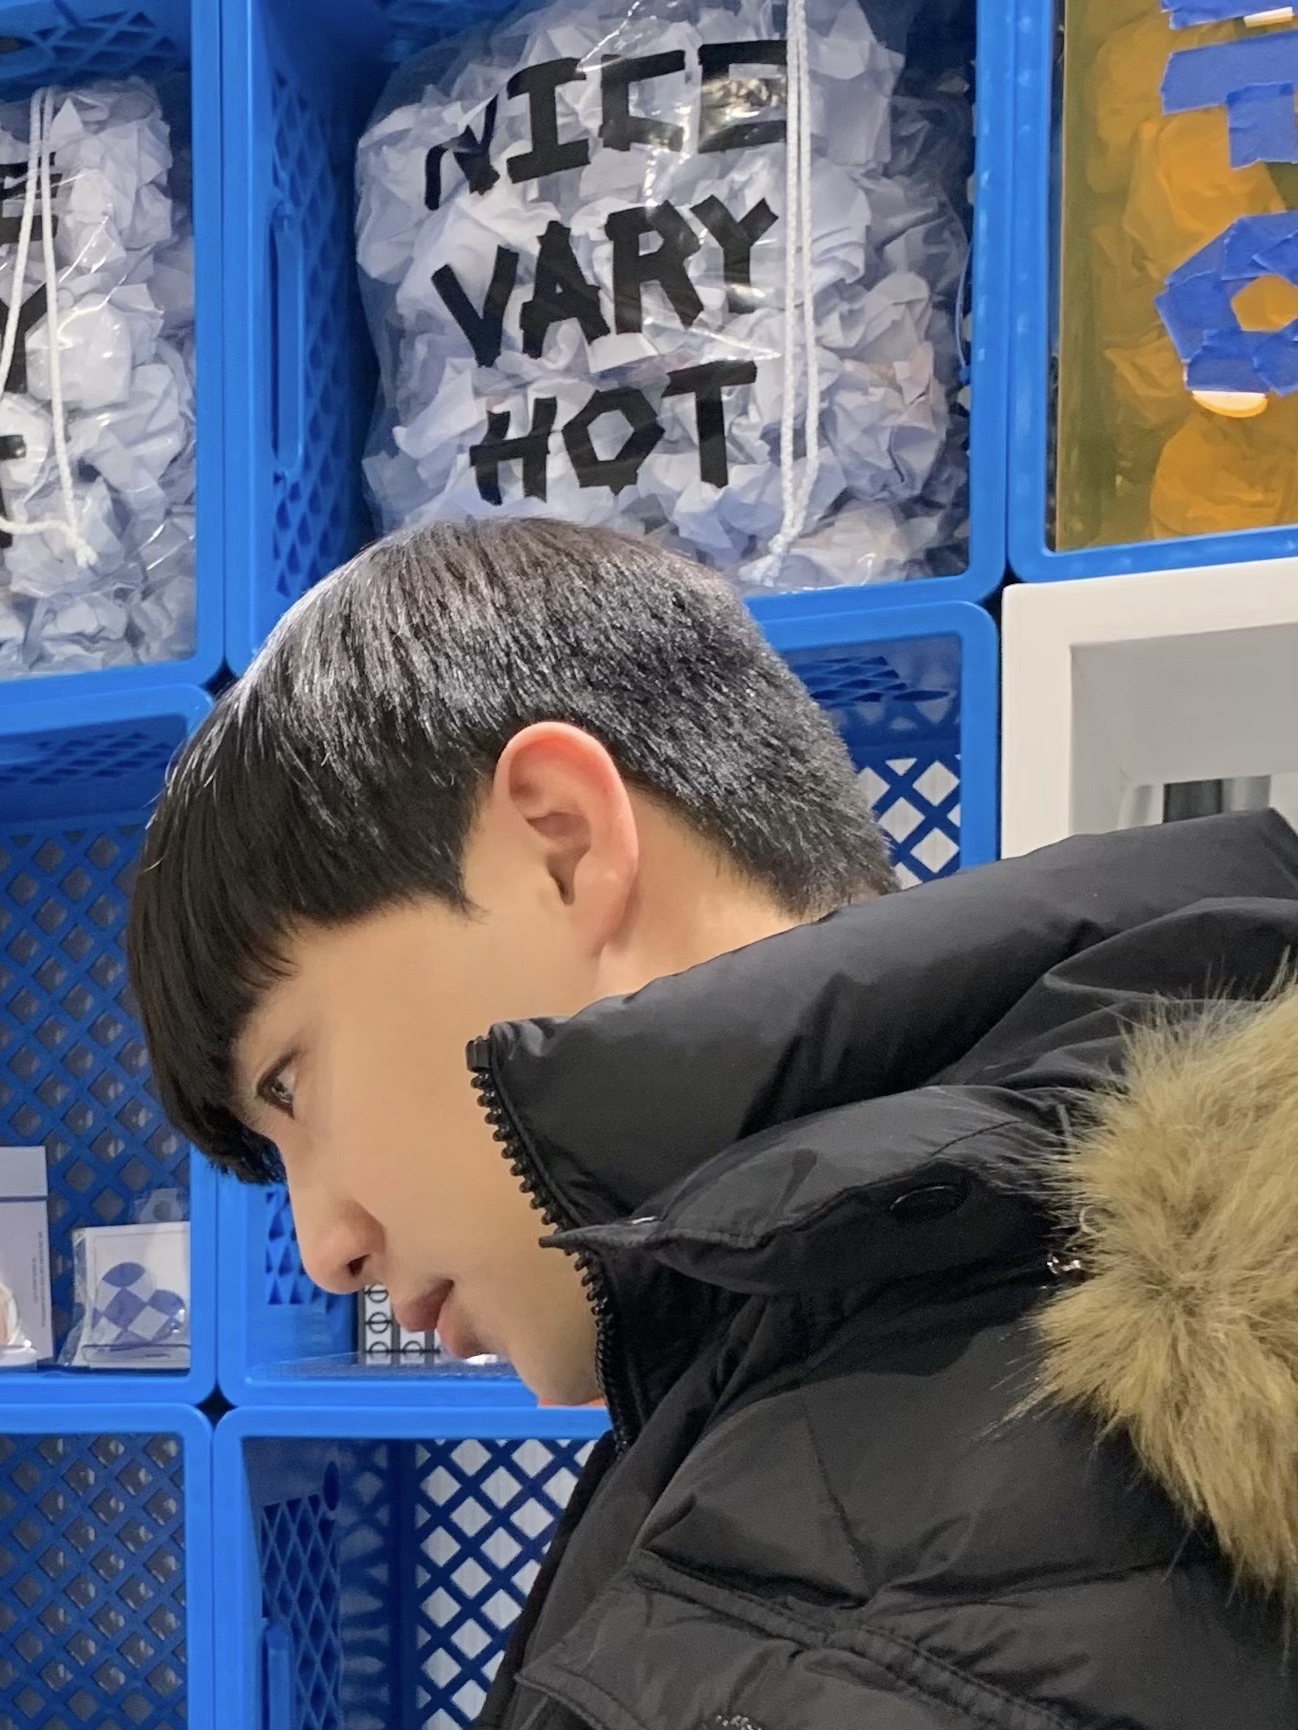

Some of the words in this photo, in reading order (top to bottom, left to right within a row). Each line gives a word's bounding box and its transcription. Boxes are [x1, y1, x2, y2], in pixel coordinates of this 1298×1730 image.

[425, 39, 788, 210] NICE
[430, 194, 779, 368] VARY
[469, 360, 758, 507] HOT
